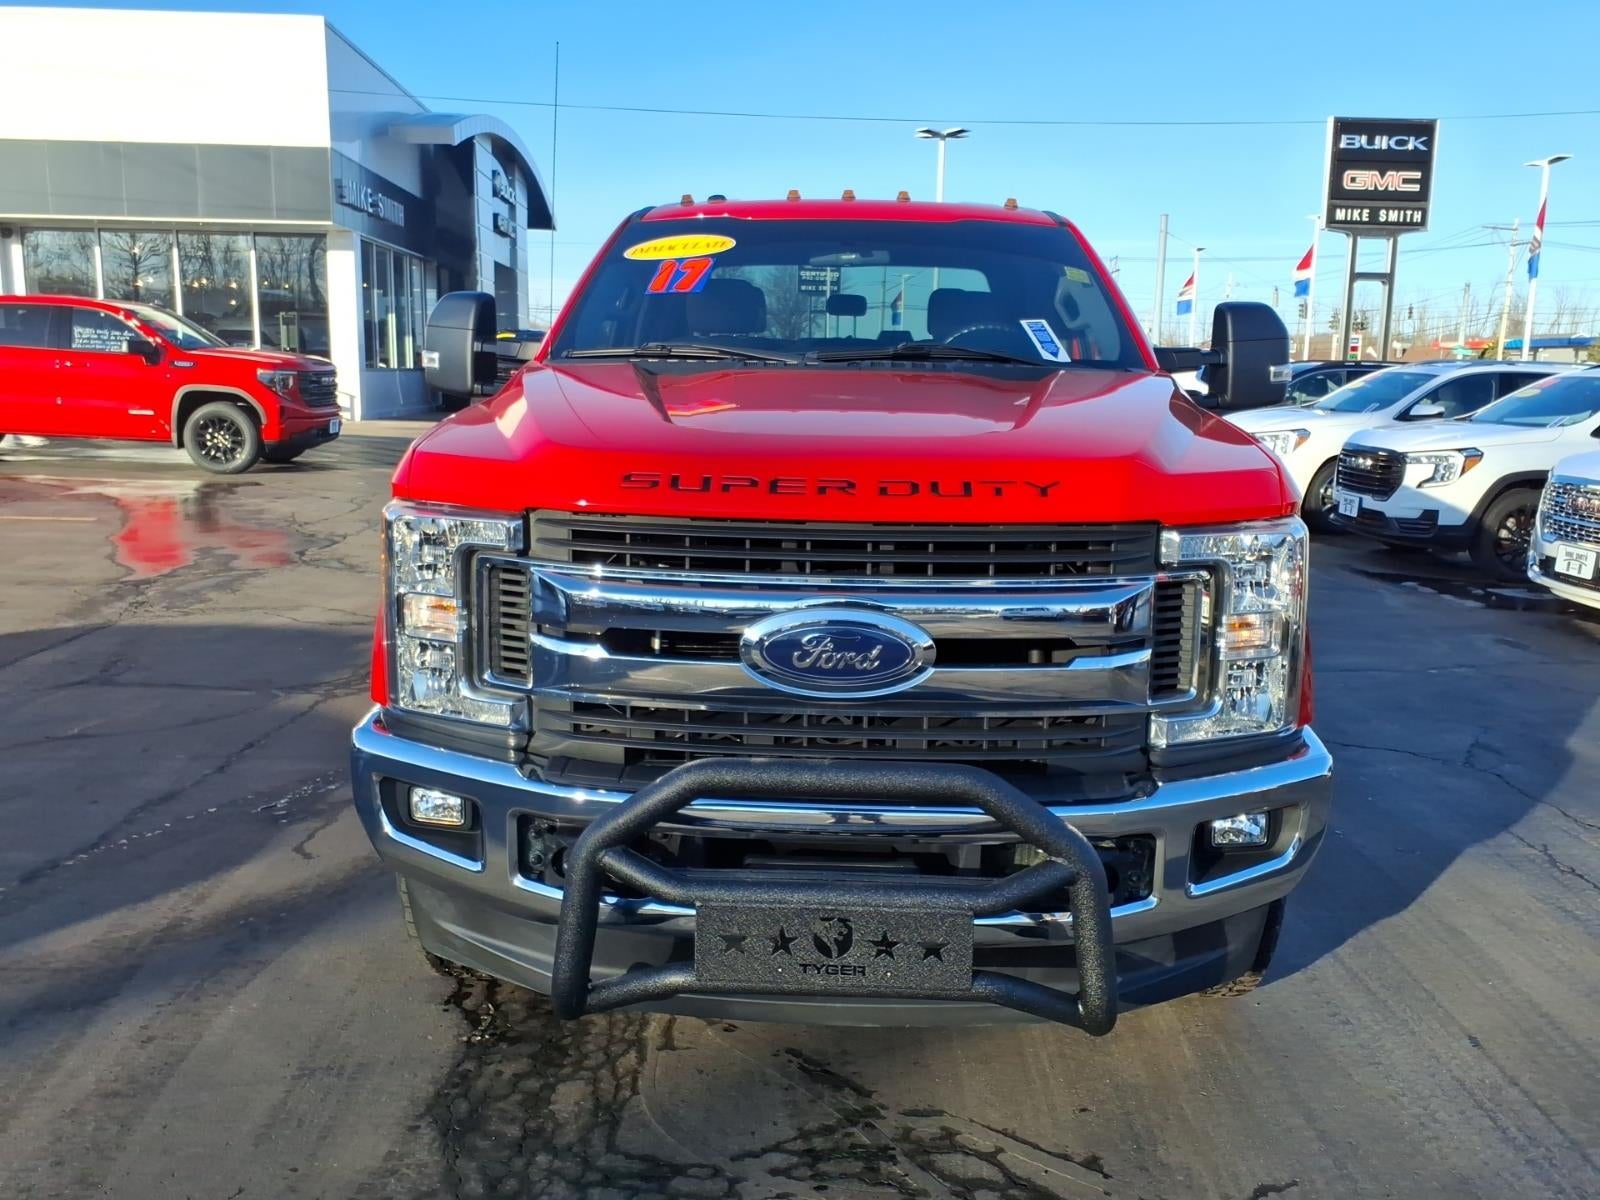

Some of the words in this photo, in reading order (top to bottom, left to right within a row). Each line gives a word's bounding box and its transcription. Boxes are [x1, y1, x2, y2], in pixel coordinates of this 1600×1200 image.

[1340, 134, 1428, 151] BUICK
[1343, 170, 1422, 191] GMC
[345, 179, 373, 213] MIKE
[1335, 208, 1370, 221] MIKE
[1379, 209, 1422, 223] SMITH
[648, 257, 714, 293] 17
[622, 472, 857, 495] SUPER
[878, 480, 1061, 498] DUTY
[792, 633, 883, 671] Ford
[799, 963, 866, 976] TYGER
